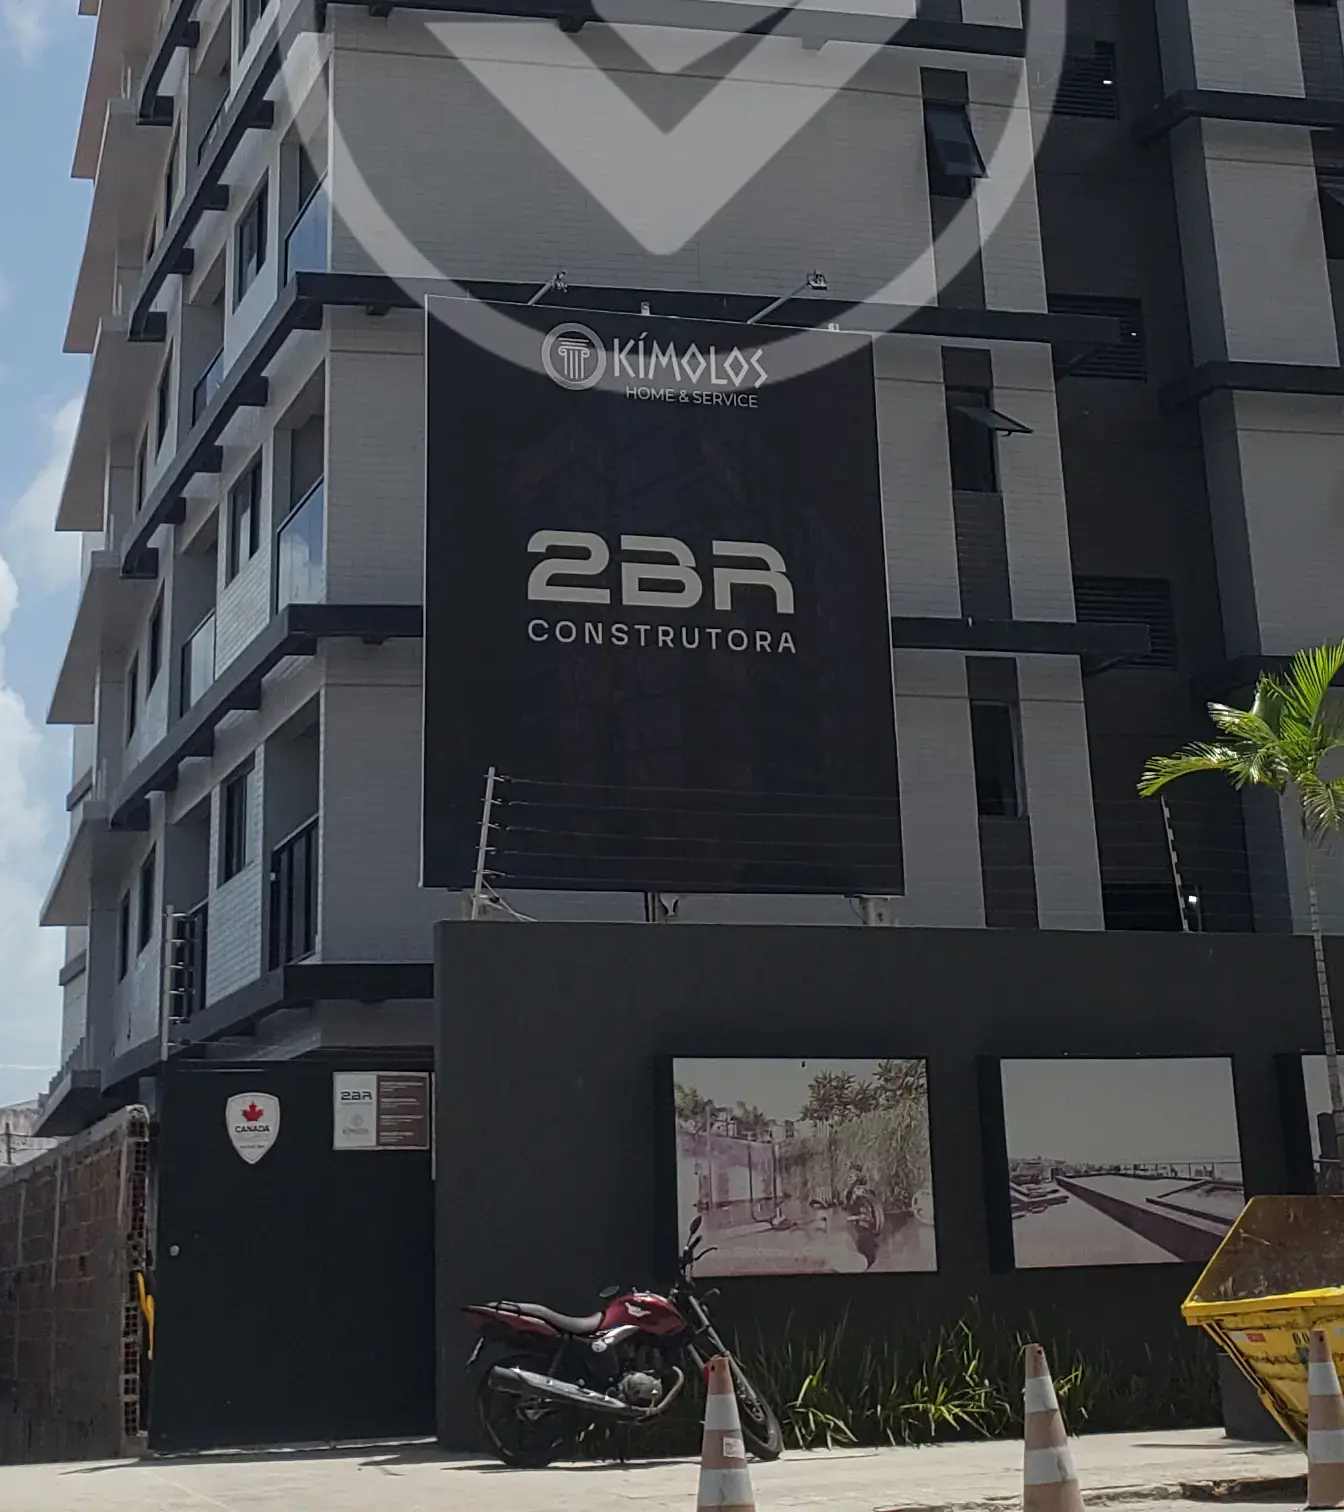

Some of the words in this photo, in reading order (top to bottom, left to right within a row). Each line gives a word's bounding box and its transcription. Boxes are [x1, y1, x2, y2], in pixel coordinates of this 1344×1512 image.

[613, 332, 768, 389] KÍMOLOS
[626, 385, 675, 402] HOME
[678, 389, 690, 403] &
[692, 390, 759, 408] SERVICE
[527, 530, 795, 614] 2BR
[527, 619, 797, 654] CONSTRUTORA
[235, 1125, 270, 1133] CANADA
